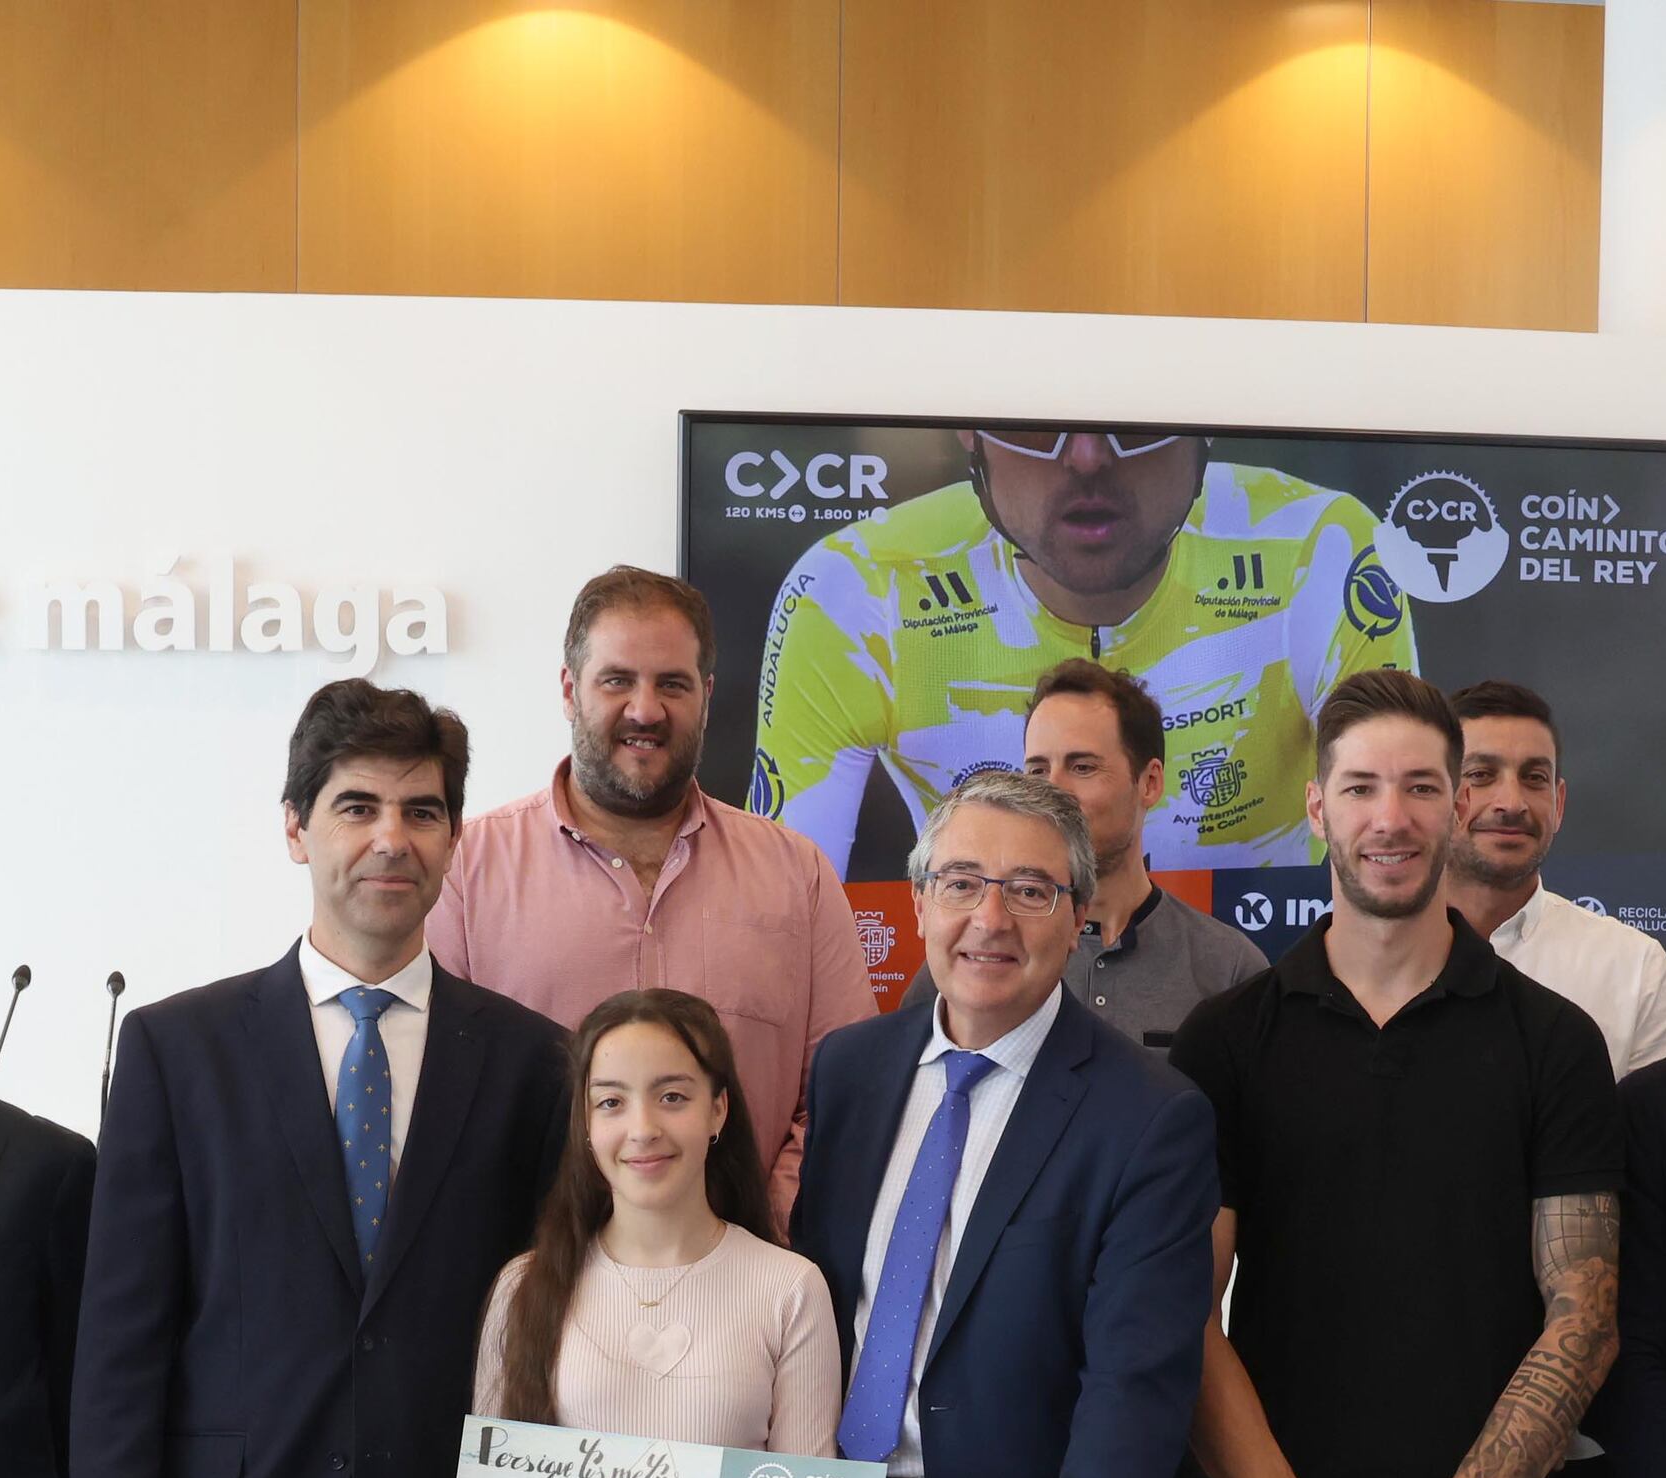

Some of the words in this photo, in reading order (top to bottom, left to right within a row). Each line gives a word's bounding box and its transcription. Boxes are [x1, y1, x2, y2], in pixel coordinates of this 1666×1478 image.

[725, 507, 751, 519] 120
[755, 508, 786, 519] KMS
[813, 509, 852, 521] 1.800
[1520, 557, 1580, 582] DEL
[1594, 560, 1657, 585] REY
[1195, 594, 1242, 607] Diputación
[1242, 594, 1281, 607] Provincial
[33, 553, 450, 680] málaga
[902, 613, 954, 630] Diputación
[954, 603, 999, 622] Provincial
[1214, 608, 1225, 618] de
[1226, 607, 1259, 620] Málaga
[930, 628, 943, 638] de
[944, 621, 979, 637] Málaga
[1173, 797, 1265, 826] Ayuntamiento
[1197, 822, 1214, 835] de
[869, 971, 906, 981] miento
[872, 983, 889, 993] oín
